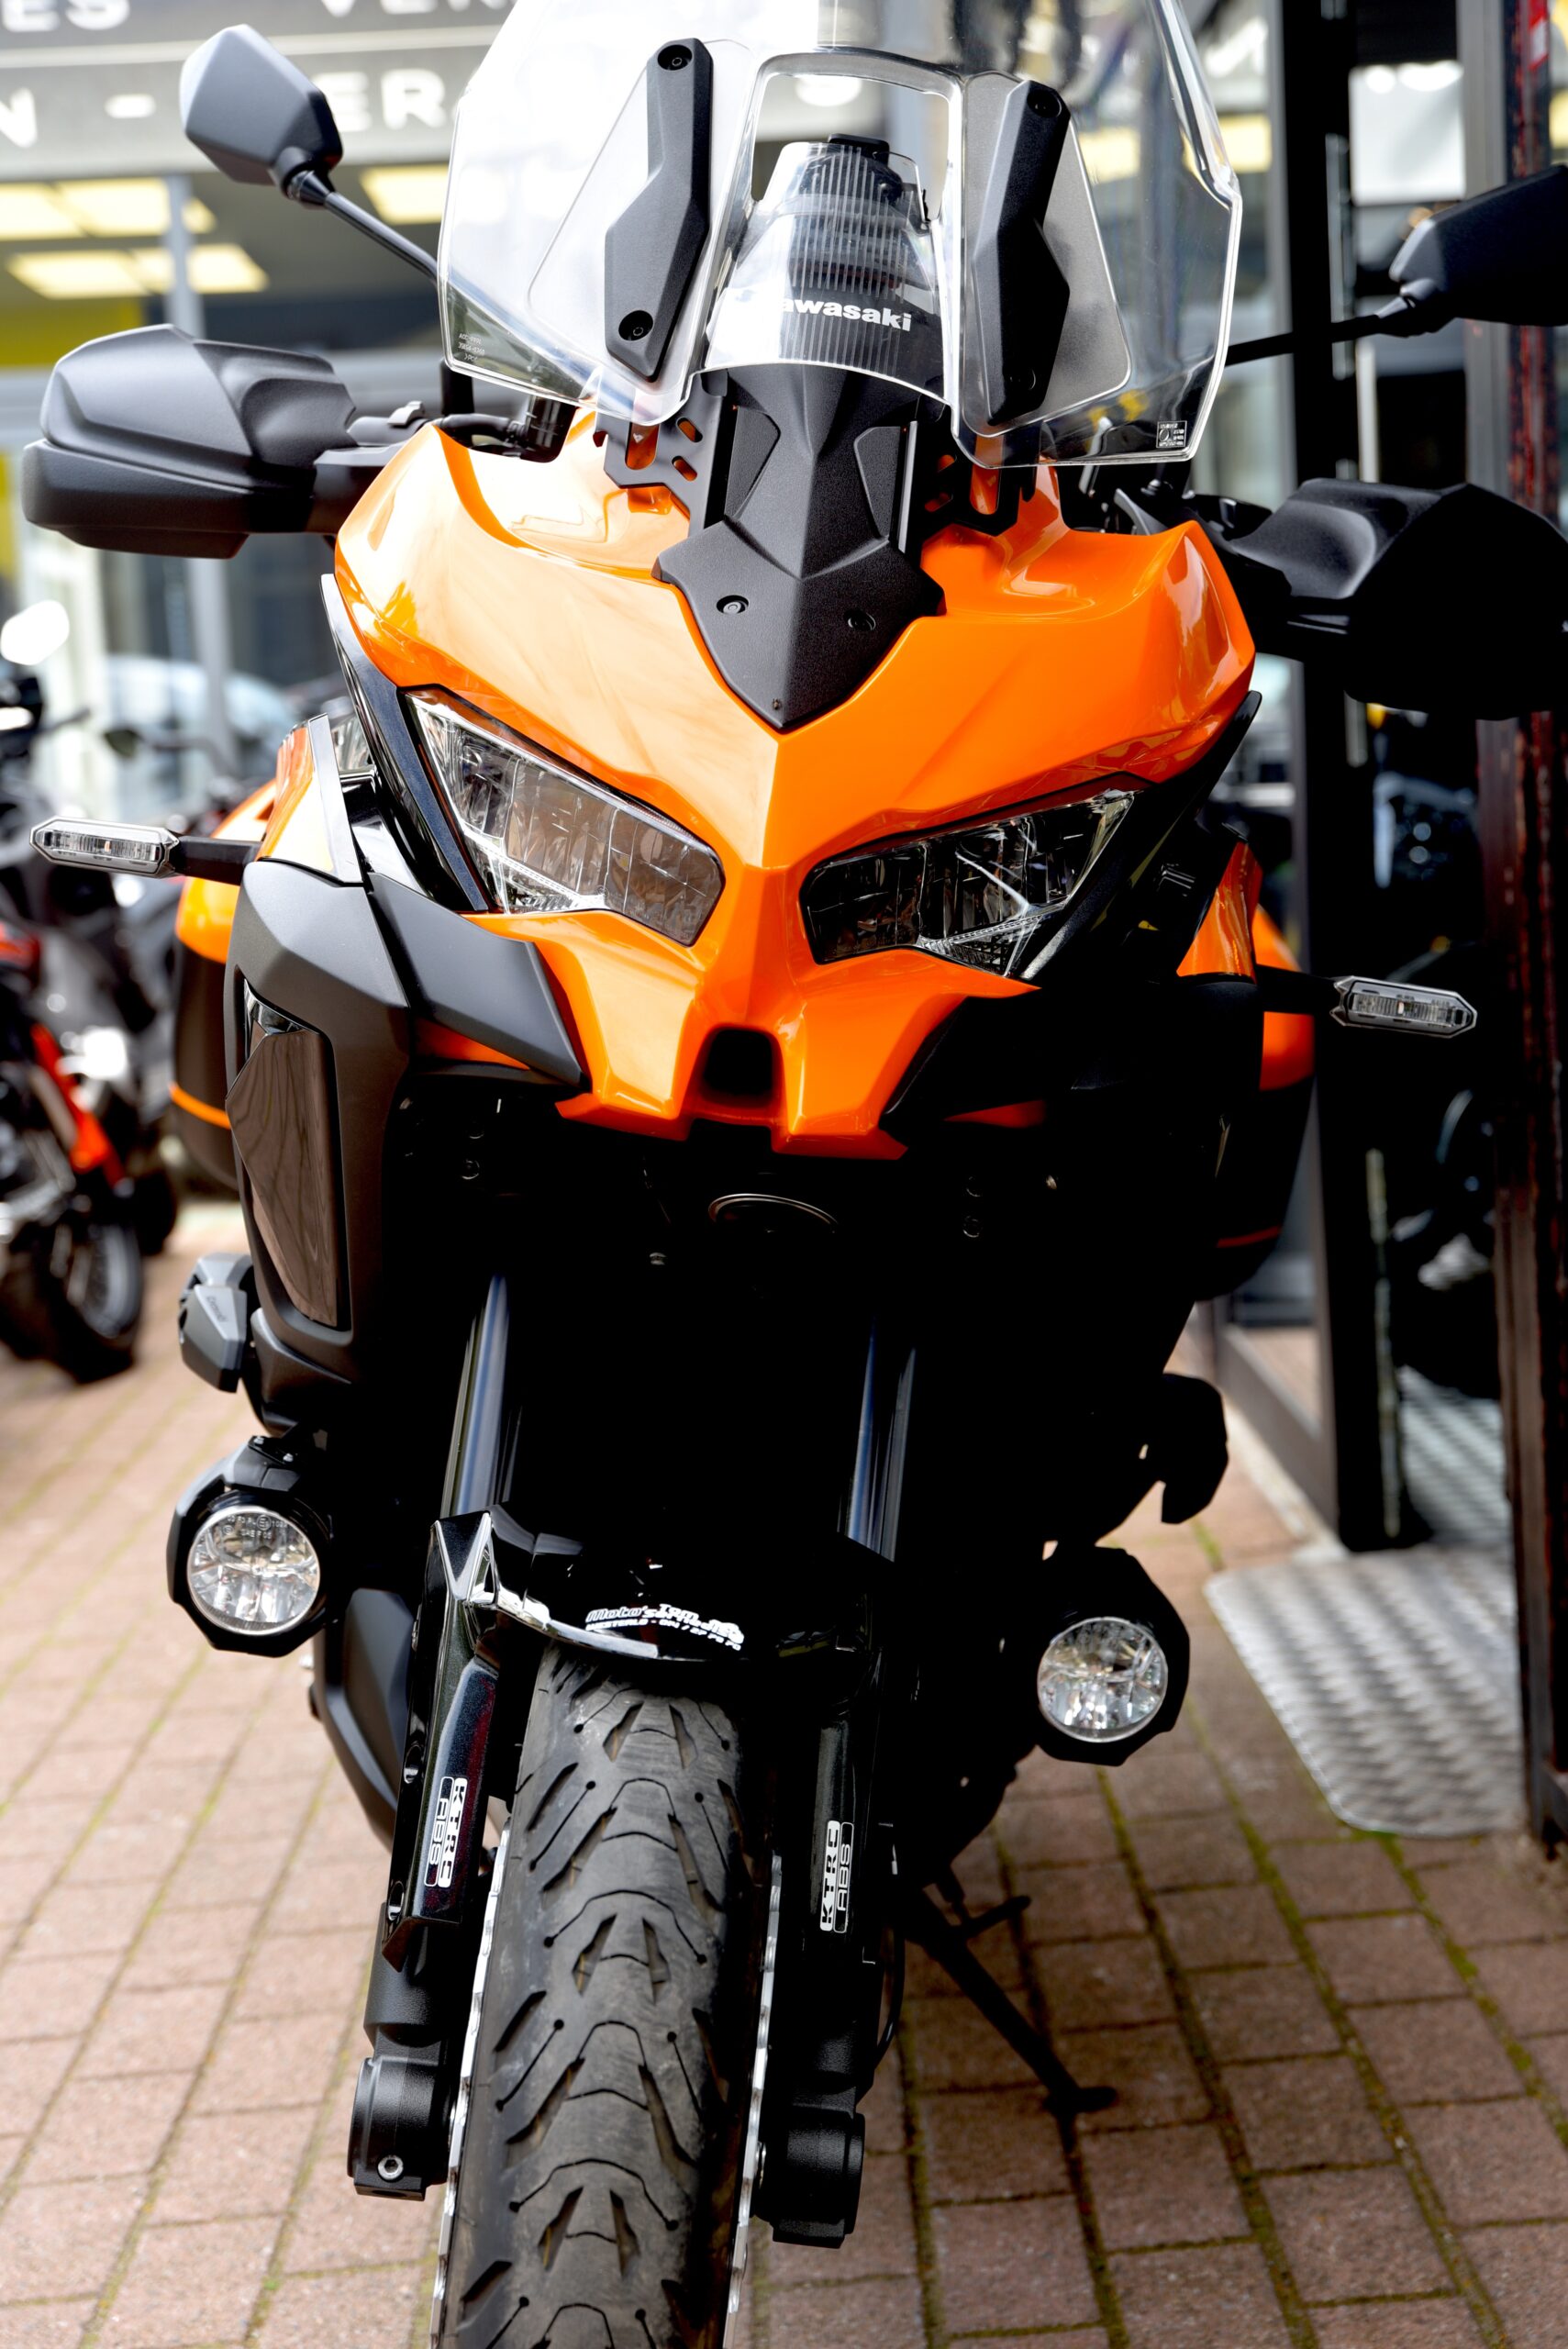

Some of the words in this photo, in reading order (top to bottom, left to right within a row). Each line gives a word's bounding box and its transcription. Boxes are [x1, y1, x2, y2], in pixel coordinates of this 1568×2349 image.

[780, 297, 912, 332] awasaki
[428, 1798, 449, 1865] ABS
[439, 1784, 466, 1881] KTRC
[821, 1827, 839, 1925] KTRC
[837, 1843, 851, 1911] ABS
